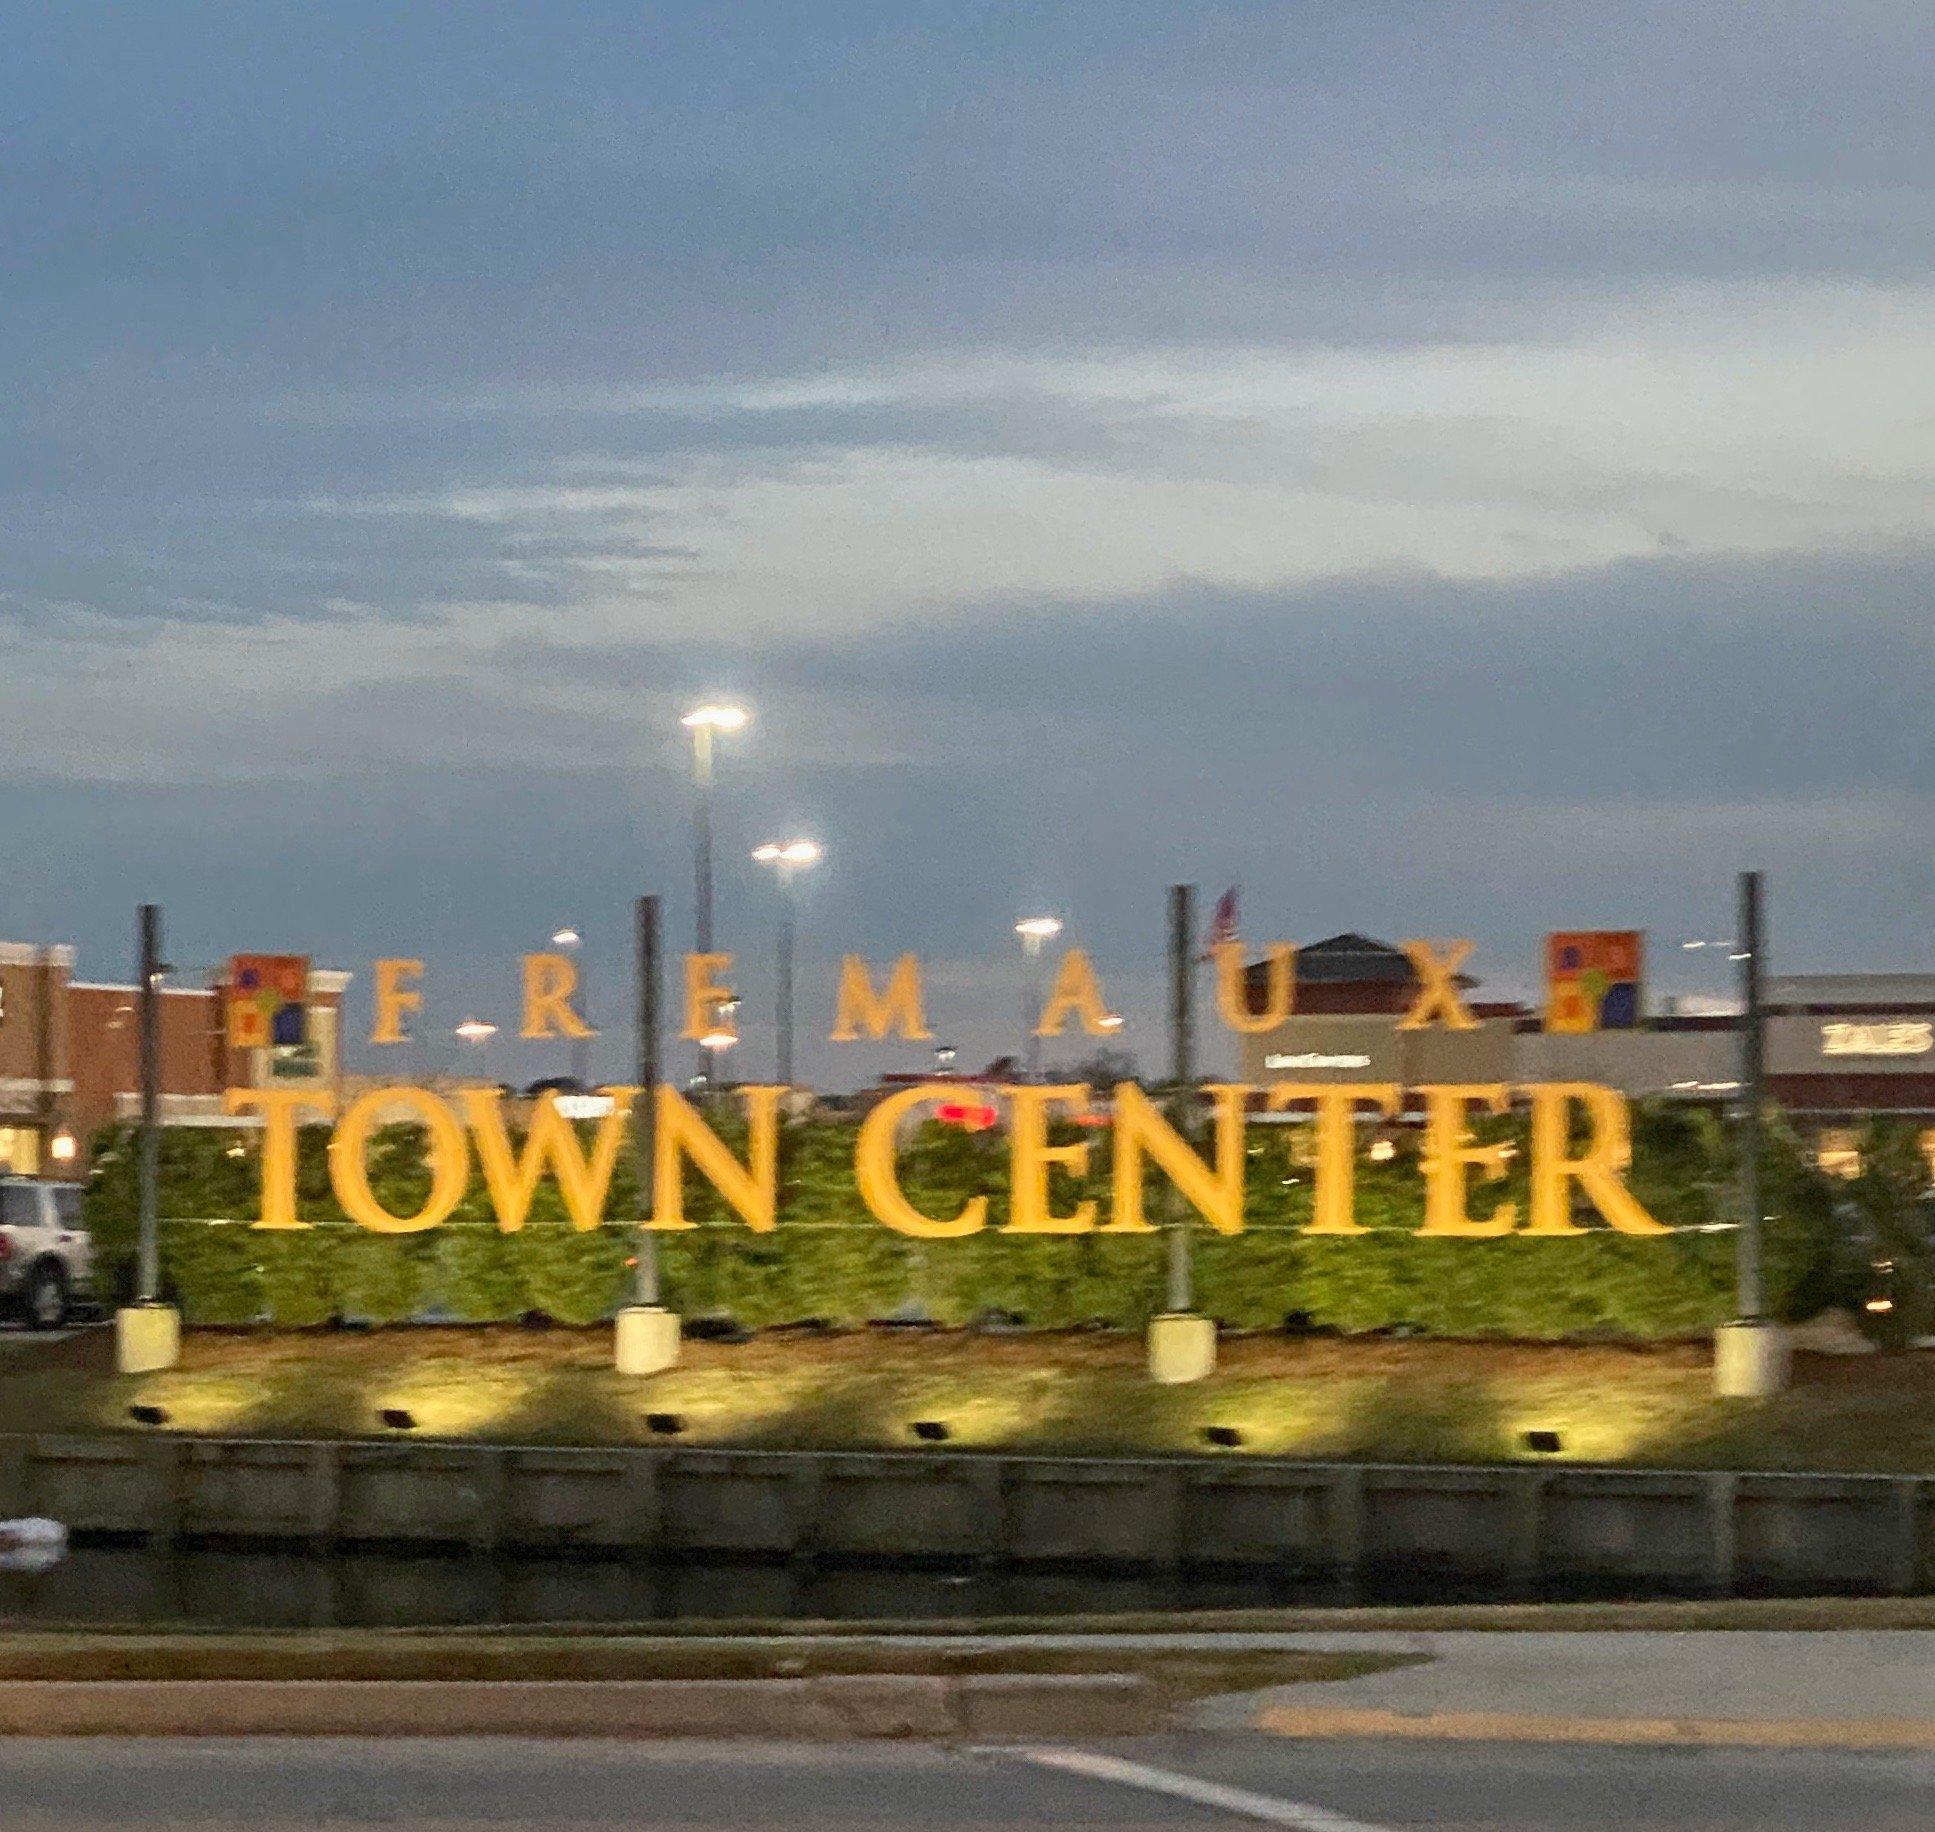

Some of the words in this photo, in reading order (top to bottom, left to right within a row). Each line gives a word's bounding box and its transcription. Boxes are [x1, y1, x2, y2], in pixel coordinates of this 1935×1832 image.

[372, 939, 1478, 1043] FREMAUX
[225, 1085, 794, 1233] TOWN
[854, 1081, 1673, 1238] CENTER
